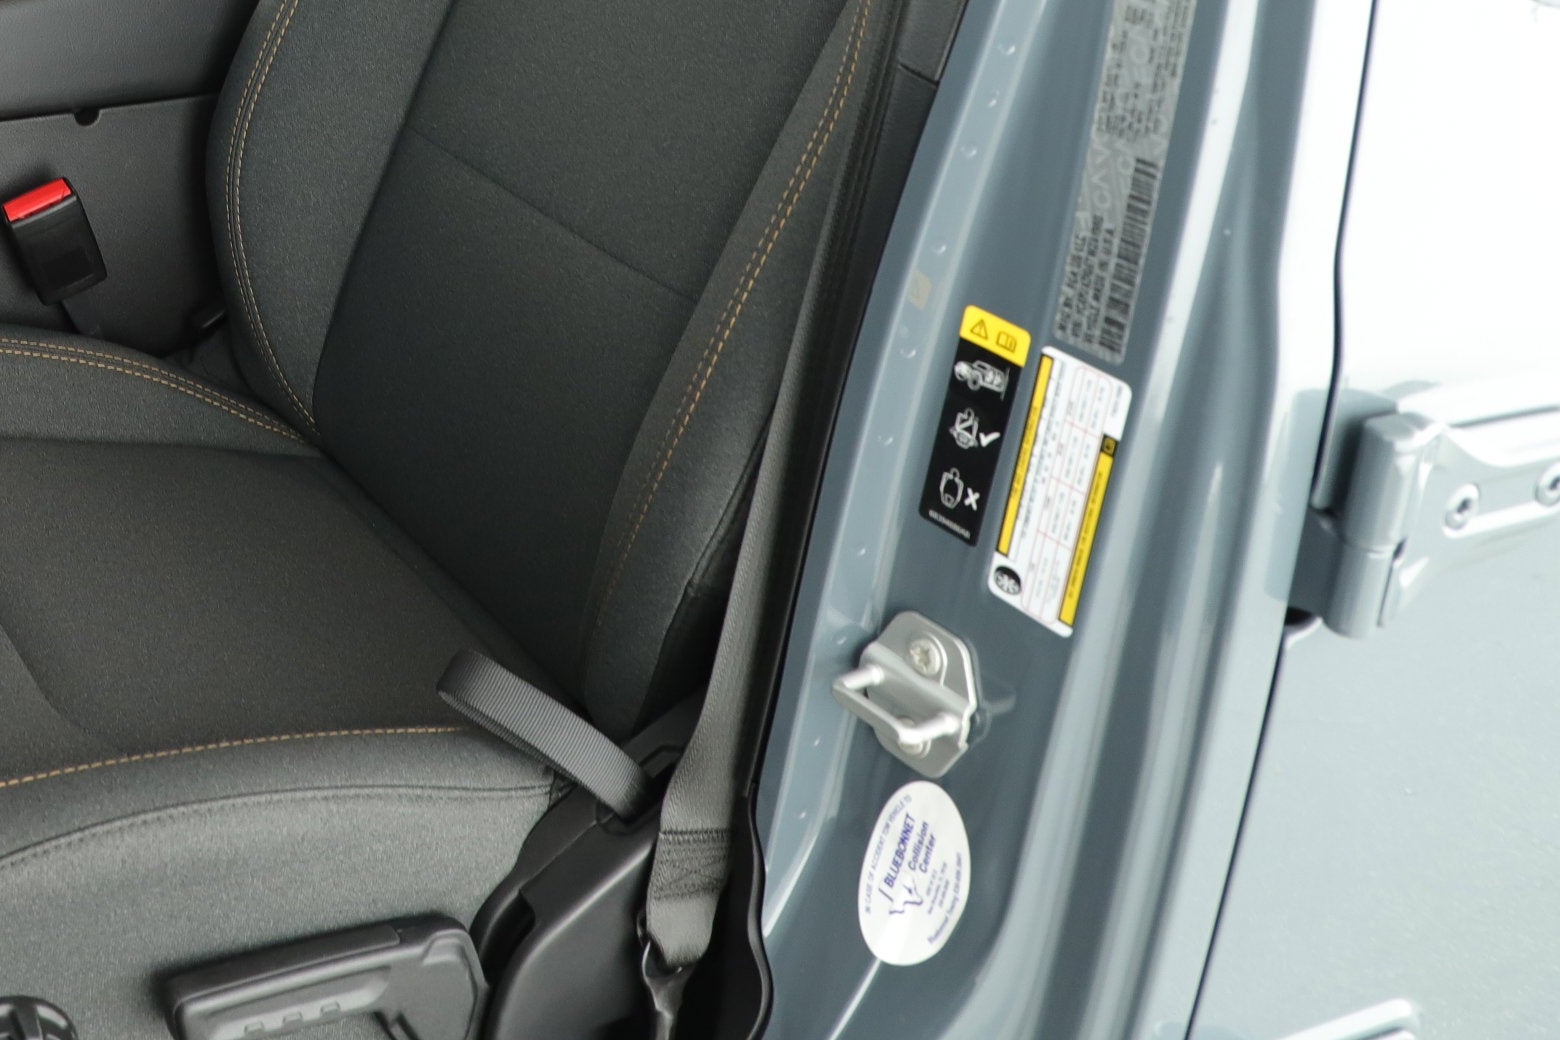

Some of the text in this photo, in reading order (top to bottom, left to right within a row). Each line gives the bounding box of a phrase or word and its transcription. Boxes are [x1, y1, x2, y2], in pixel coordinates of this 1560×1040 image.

[883, 812, 916, 888] BLUEBONNET
[908, 820, 929, 871] Collision
[918, 833, 936, 874] Center
